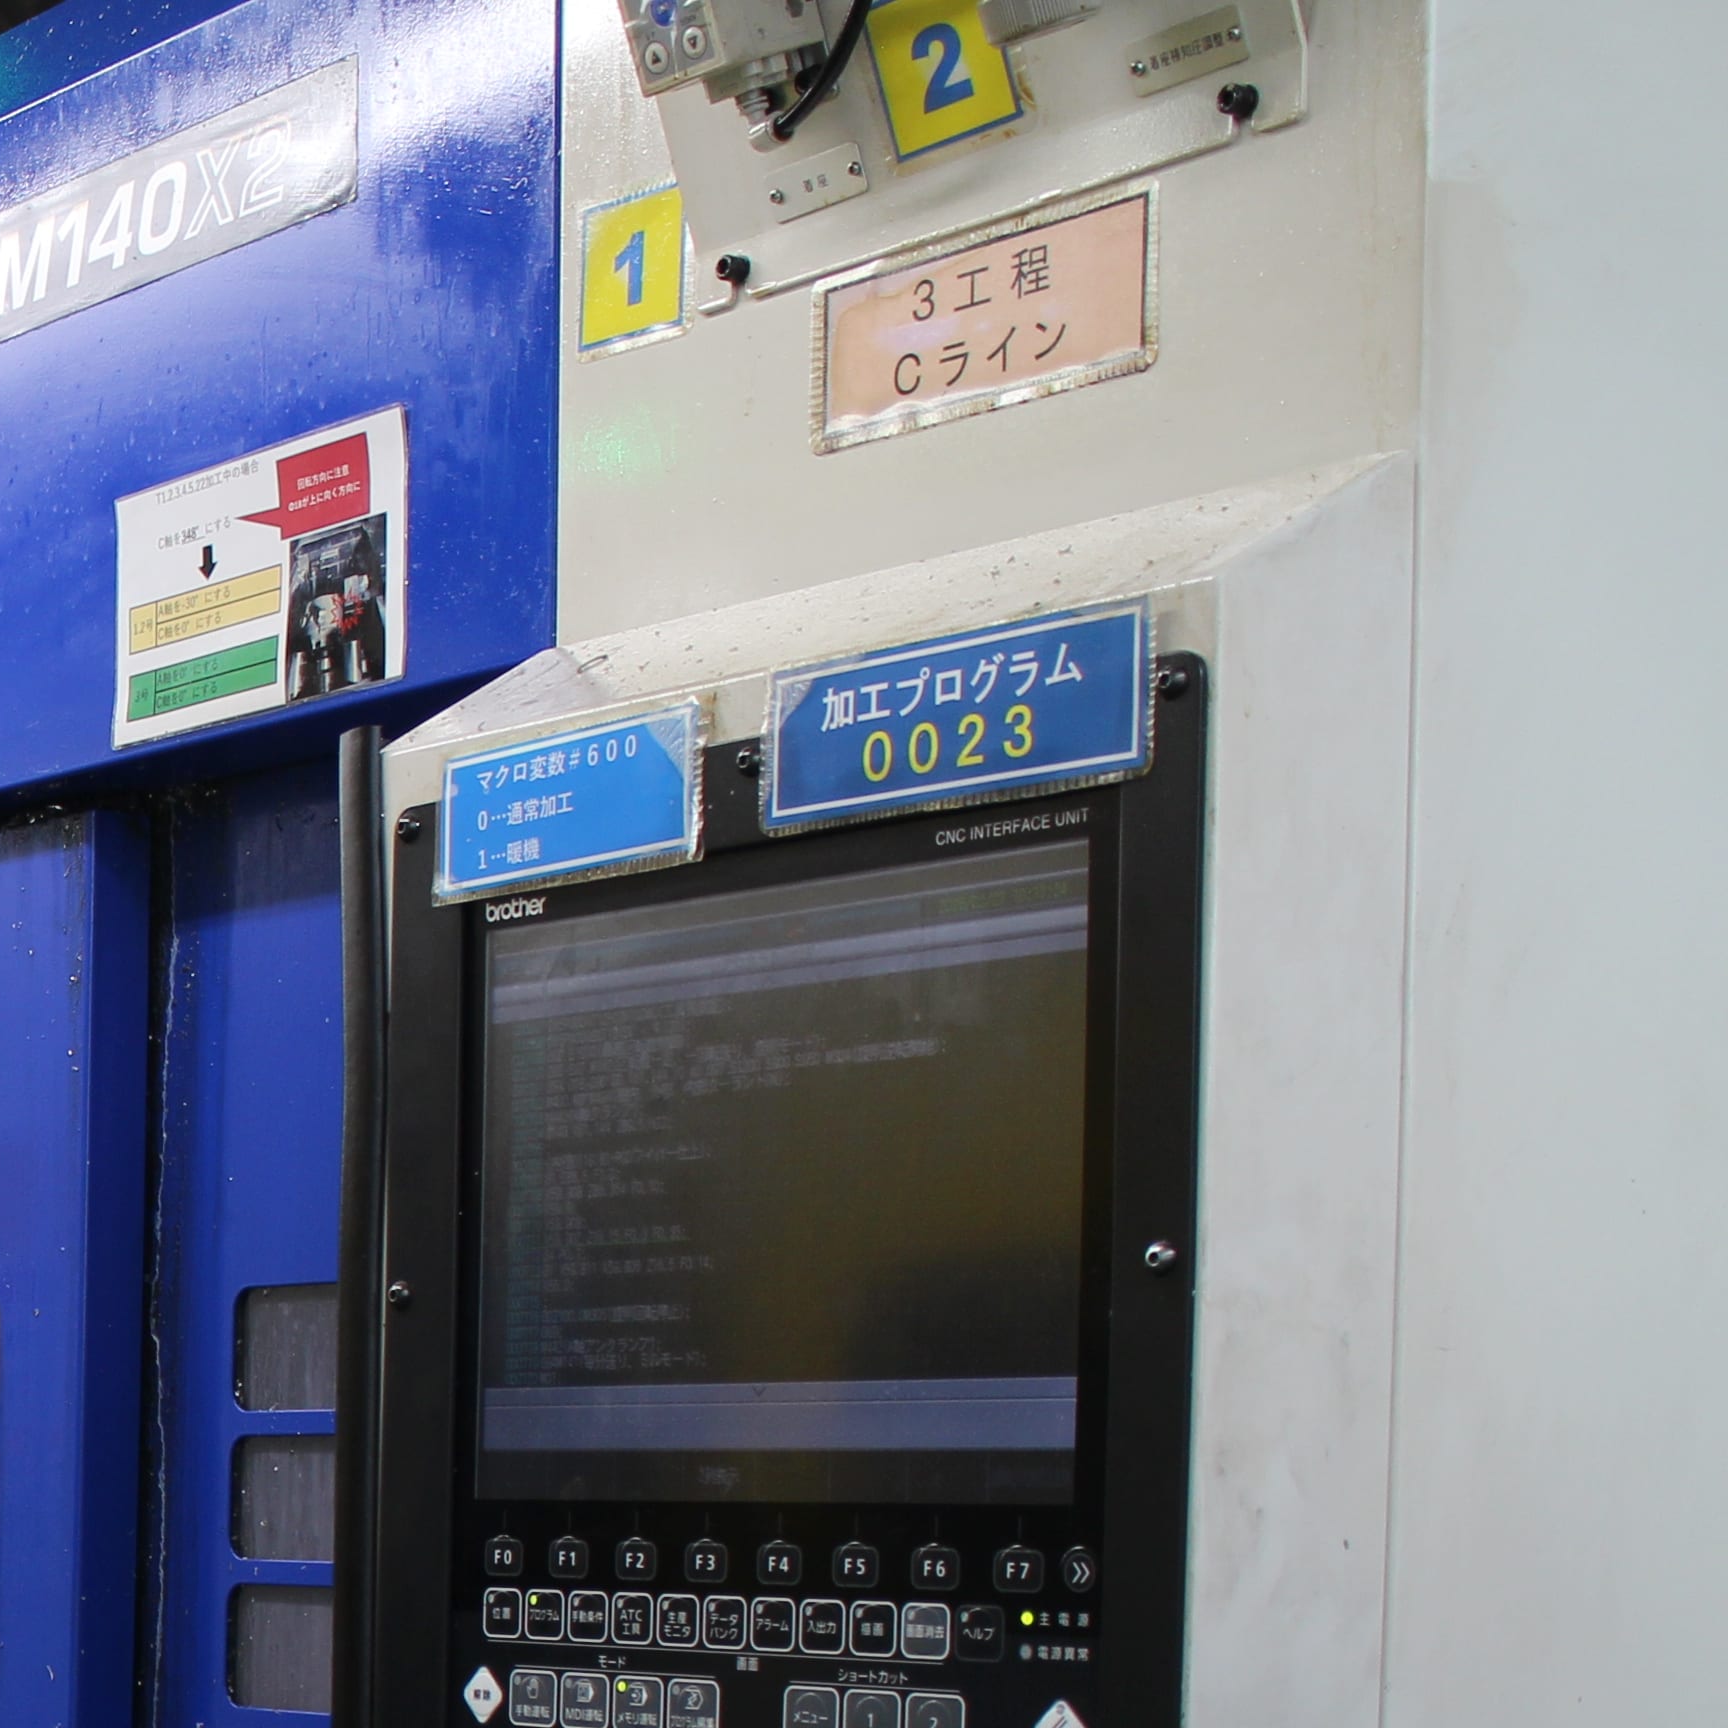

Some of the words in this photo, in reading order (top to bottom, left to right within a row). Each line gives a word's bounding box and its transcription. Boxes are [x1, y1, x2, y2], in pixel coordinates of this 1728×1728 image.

[911, 22, 975, 113] 2
[614, 230, 645, 304] 1
[912, 245, 1052, 323] 3工程
[893, 319, 1067, 395] Cライン
[821, 644, 1083, 731] 加工プログラム
[863, 704, 1034, 783] 0023
[935, 826, 966, 848] CNC
[971, 815, 1051, 843] INTERFACE
[1056, 809, 1090, 830] UNIT
[486, 897, 546, 922] brother
[494, 1550, 512, 1565] F0
[558, 1552, 576, 1566] F1
[626, 1553, 645, 1568] F2
[696, 1555, 715, 1570] F3
[769, 1557, 788, 1572] F4
[844, 1559, 865, 1574] F5
[924, 1561, 945, 1577] F6
[1006, 1563, 1029, 1579] F7
[620, 1610, 642, 1621] ATC
[710, 1614, 738, 1626] データ
[756, 1618, 789, 1631] アラーム
[598, 1656, 626, 1668] モード
[838, 1668, 908, 1684] ショートカット
